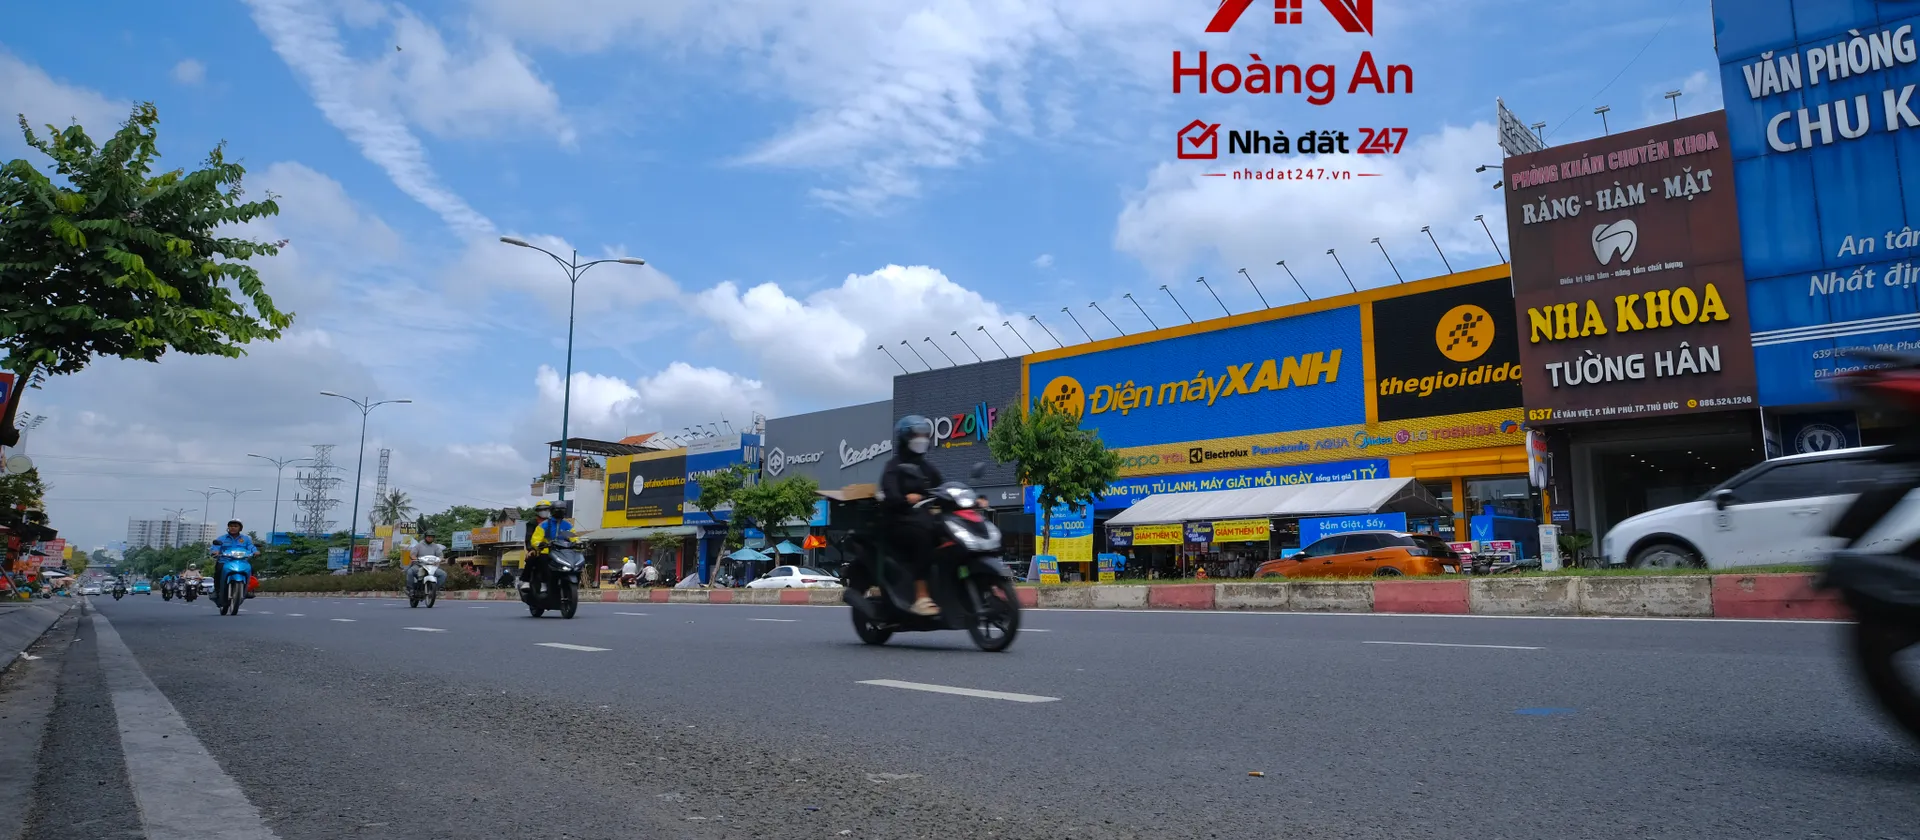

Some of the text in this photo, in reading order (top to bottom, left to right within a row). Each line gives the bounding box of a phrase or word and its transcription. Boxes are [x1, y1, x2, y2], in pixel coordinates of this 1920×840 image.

[1742, 24, 1917, 99] VĂN PHÒNG
[1766, 84, 1920, 152] CHU K
[1511, 131, 1719, 191] PHÒNG KHÁM CHUYÊN KHOA
[1522, 194, 1582, 225] RĂNG
[1596, 180, 1646, 212] HÀM
[1663, 165, 1713, 202] MẶT
[1837, 235, 1875, 258] An
[1809, 265, 1877, 297] Nhất
[1527, 282, 1730, 343] NHA KHOA
[1545, 341, 1721, 388] TƯỜNG HÂN
[1812, 349, 1831, 360] 639
[1088, 380, 1153, 416] Điện
[1528, 408, 1553, 421] 637
[1553, 409, 1562, 419] LÊ
[1314, 437, 1349, 450] AQUA
[1359, 433, 1392, 448] Midea
[1431, 424, 1496, 440] TOSHIBA
[786, 452, 820, 465] PIAGGIO
[840, 438, 892, 470] Vespa
[1204, 448, 1248, 460] Electrolux
[1252, 440, 1310, 456] Panasonic
[1130, 483, 1151, 495] TIVI,
[1152, 479, 1167, 493] TỦ
[1201, 477, 1224, 490] MÁY
[1255, 470, 1277, 487] MỖI
[1280, 470, 1314, 485] NGÀY
[1152, 528, 1170, 539] THÊM
[1235, 525, 1255, 536] THÊM
